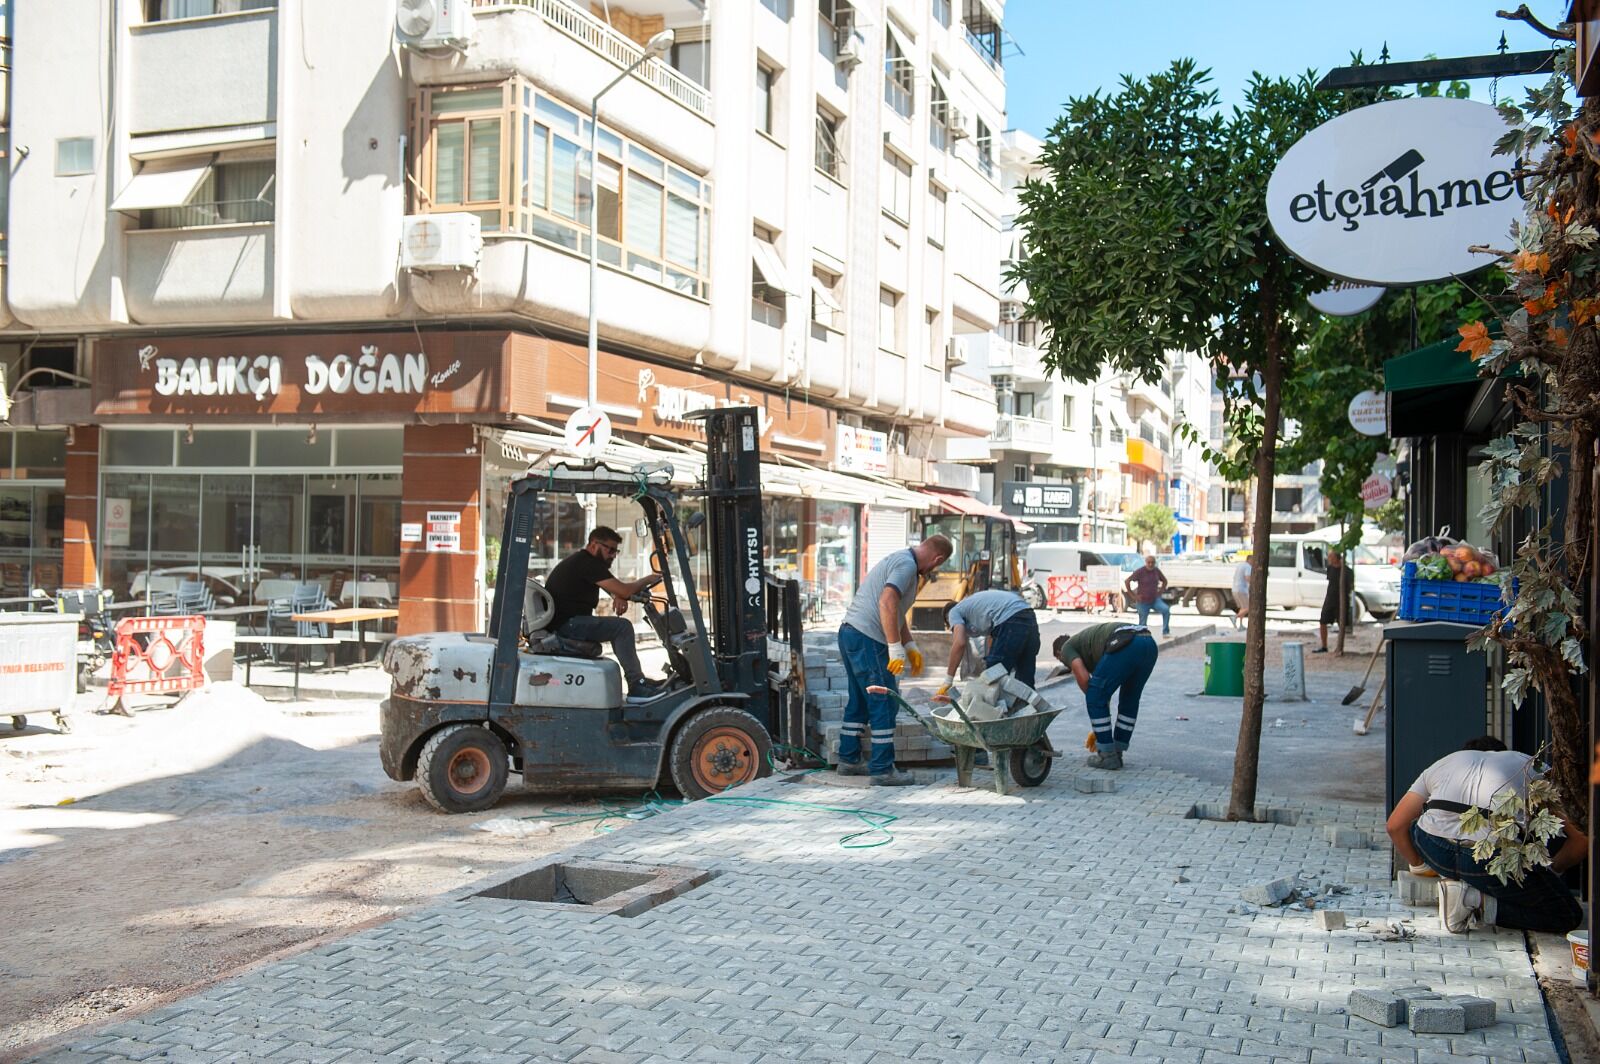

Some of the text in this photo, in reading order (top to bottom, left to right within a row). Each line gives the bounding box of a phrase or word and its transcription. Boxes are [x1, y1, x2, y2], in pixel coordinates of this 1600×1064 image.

[155, 345, 426, 401] BALIKÇI DOĞAN
[747, 527, 760, 577] HYTSU
[564, 673, 585, 687] 30
